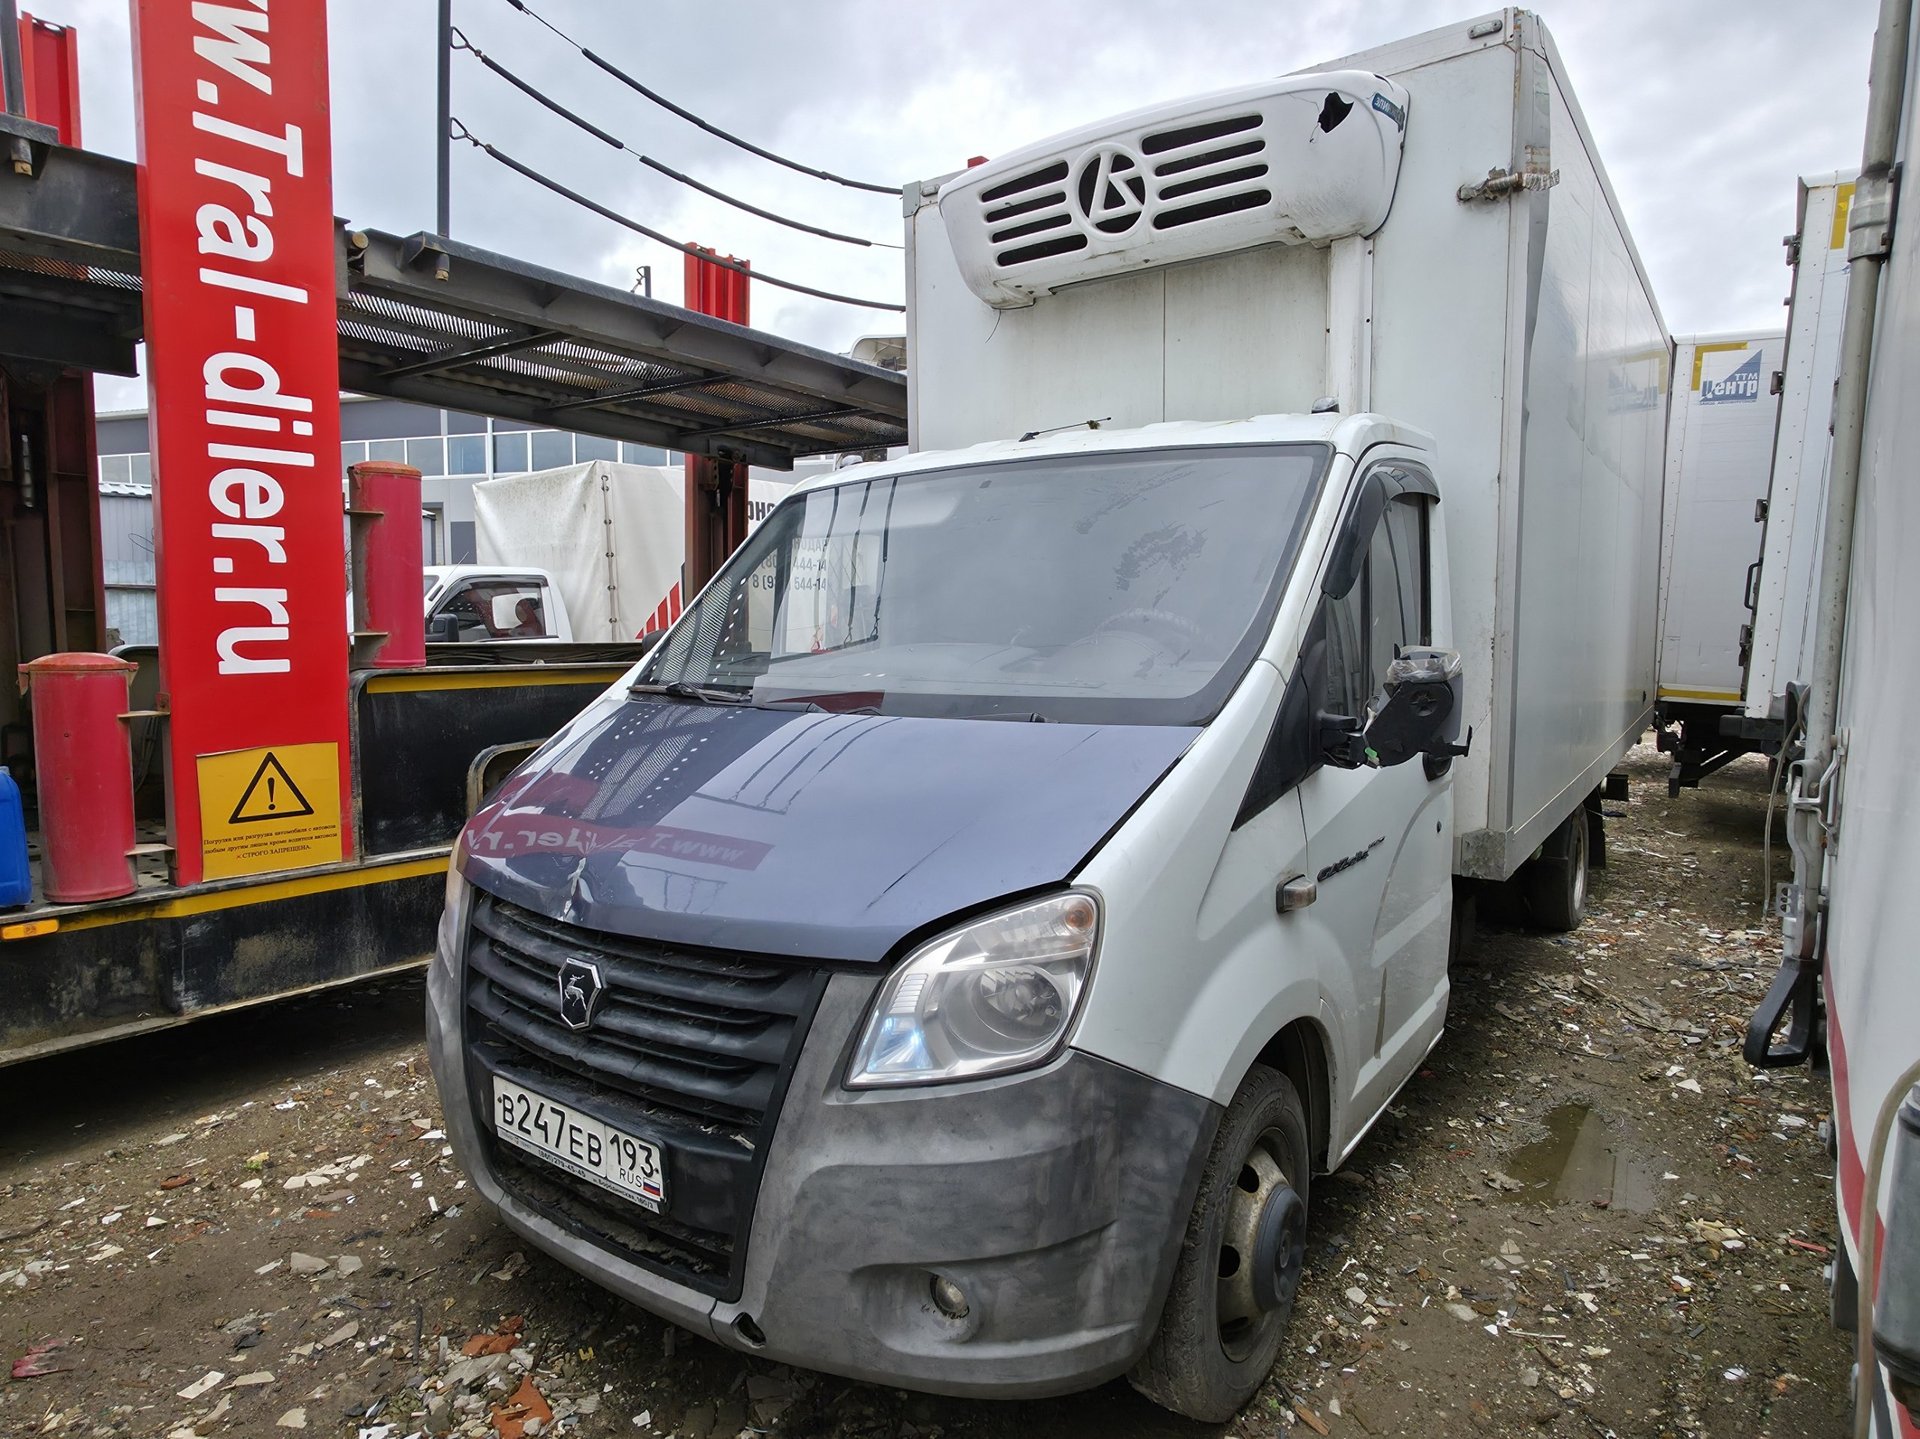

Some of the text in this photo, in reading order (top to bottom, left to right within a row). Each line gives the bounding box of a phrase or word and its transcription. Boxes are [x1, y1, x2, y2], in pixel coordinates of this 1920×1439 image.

[191, 0, 314, 675] w.Tral-diler.ru
[1701, 380, 1758, 399] Центр
[609, 1133, 655, 1178] 193
[619, 1167, 642, 1188] RUS
